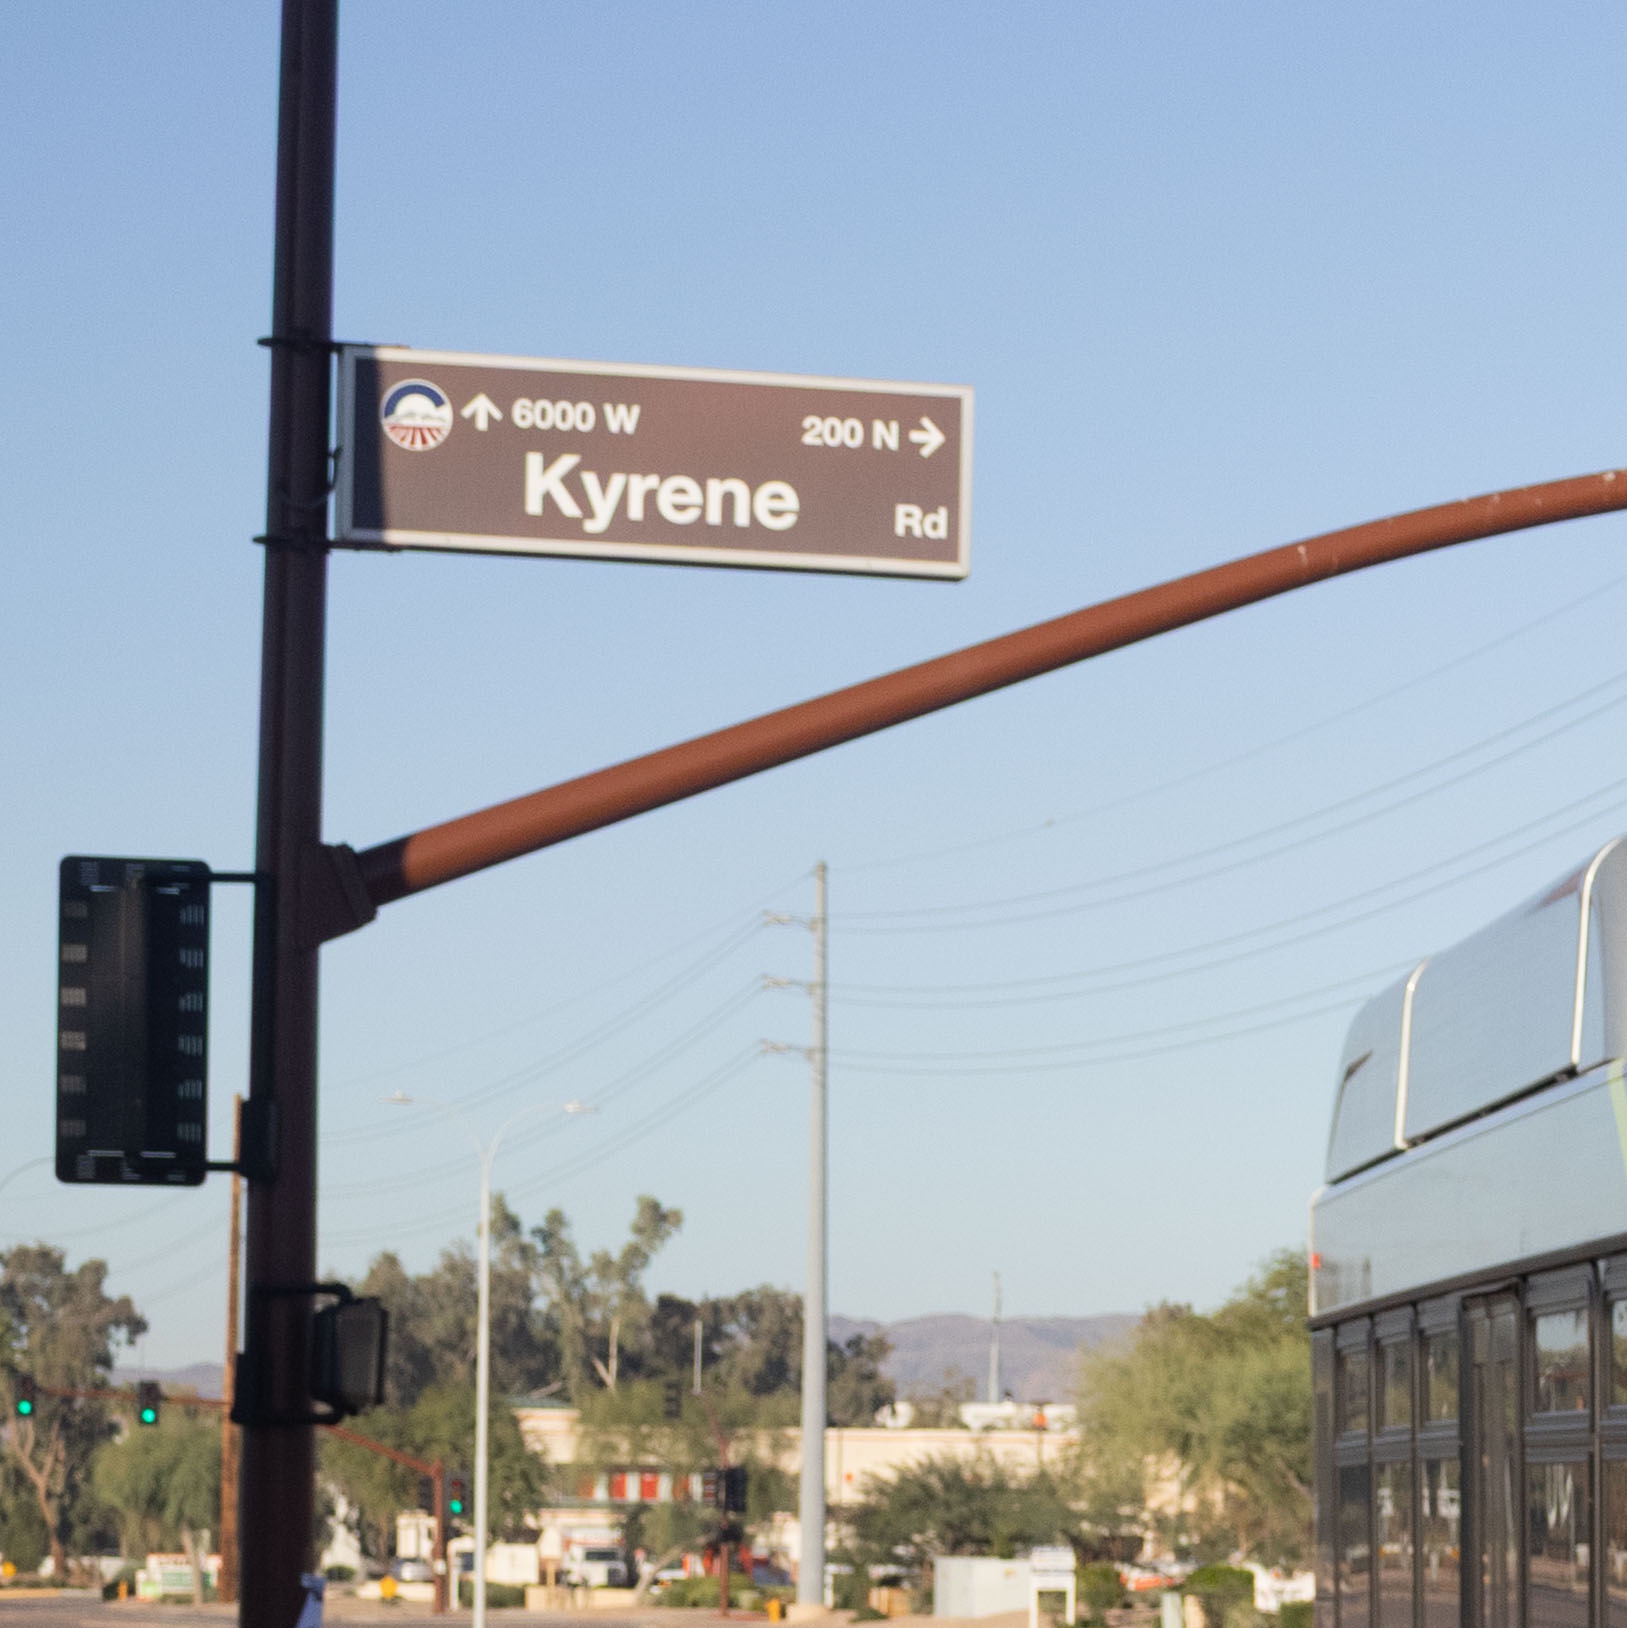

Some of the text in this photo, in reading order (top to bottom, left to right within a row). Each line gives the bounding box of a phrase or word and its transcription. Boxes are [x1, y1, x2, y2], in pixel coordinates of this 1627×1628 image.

[511, 398, 641, 435] 6000 W
[801, 416, 900, 451] 200 N
[524, 452, 949, 540] Kyrene Rd
